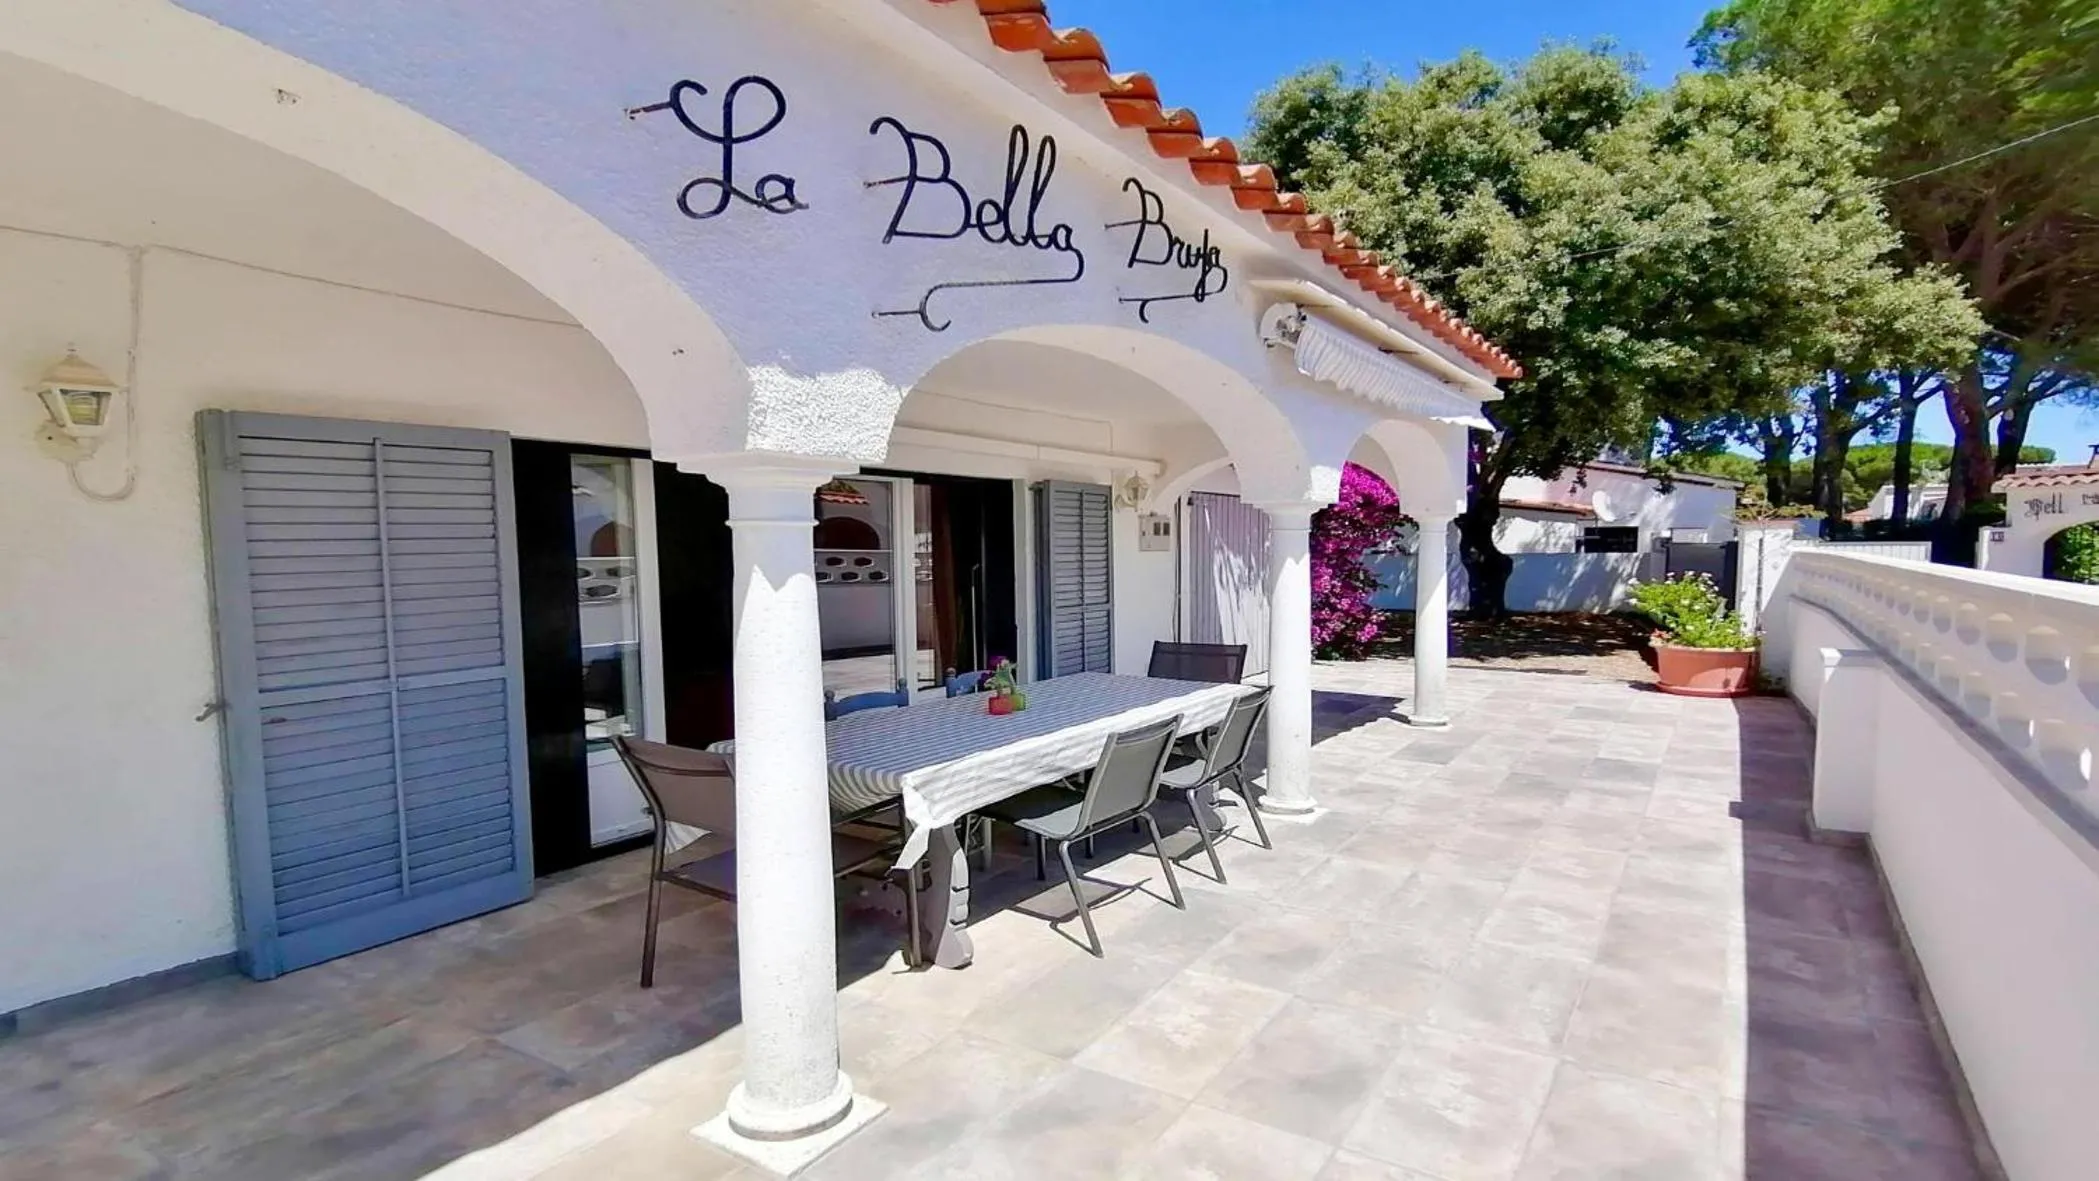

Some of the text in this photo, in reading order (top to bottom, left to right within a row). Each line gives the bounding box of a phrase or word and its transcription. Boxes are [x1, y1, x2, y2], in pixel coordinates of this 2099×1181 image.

[668, 75, 1229, 303] La Bella Bruja
